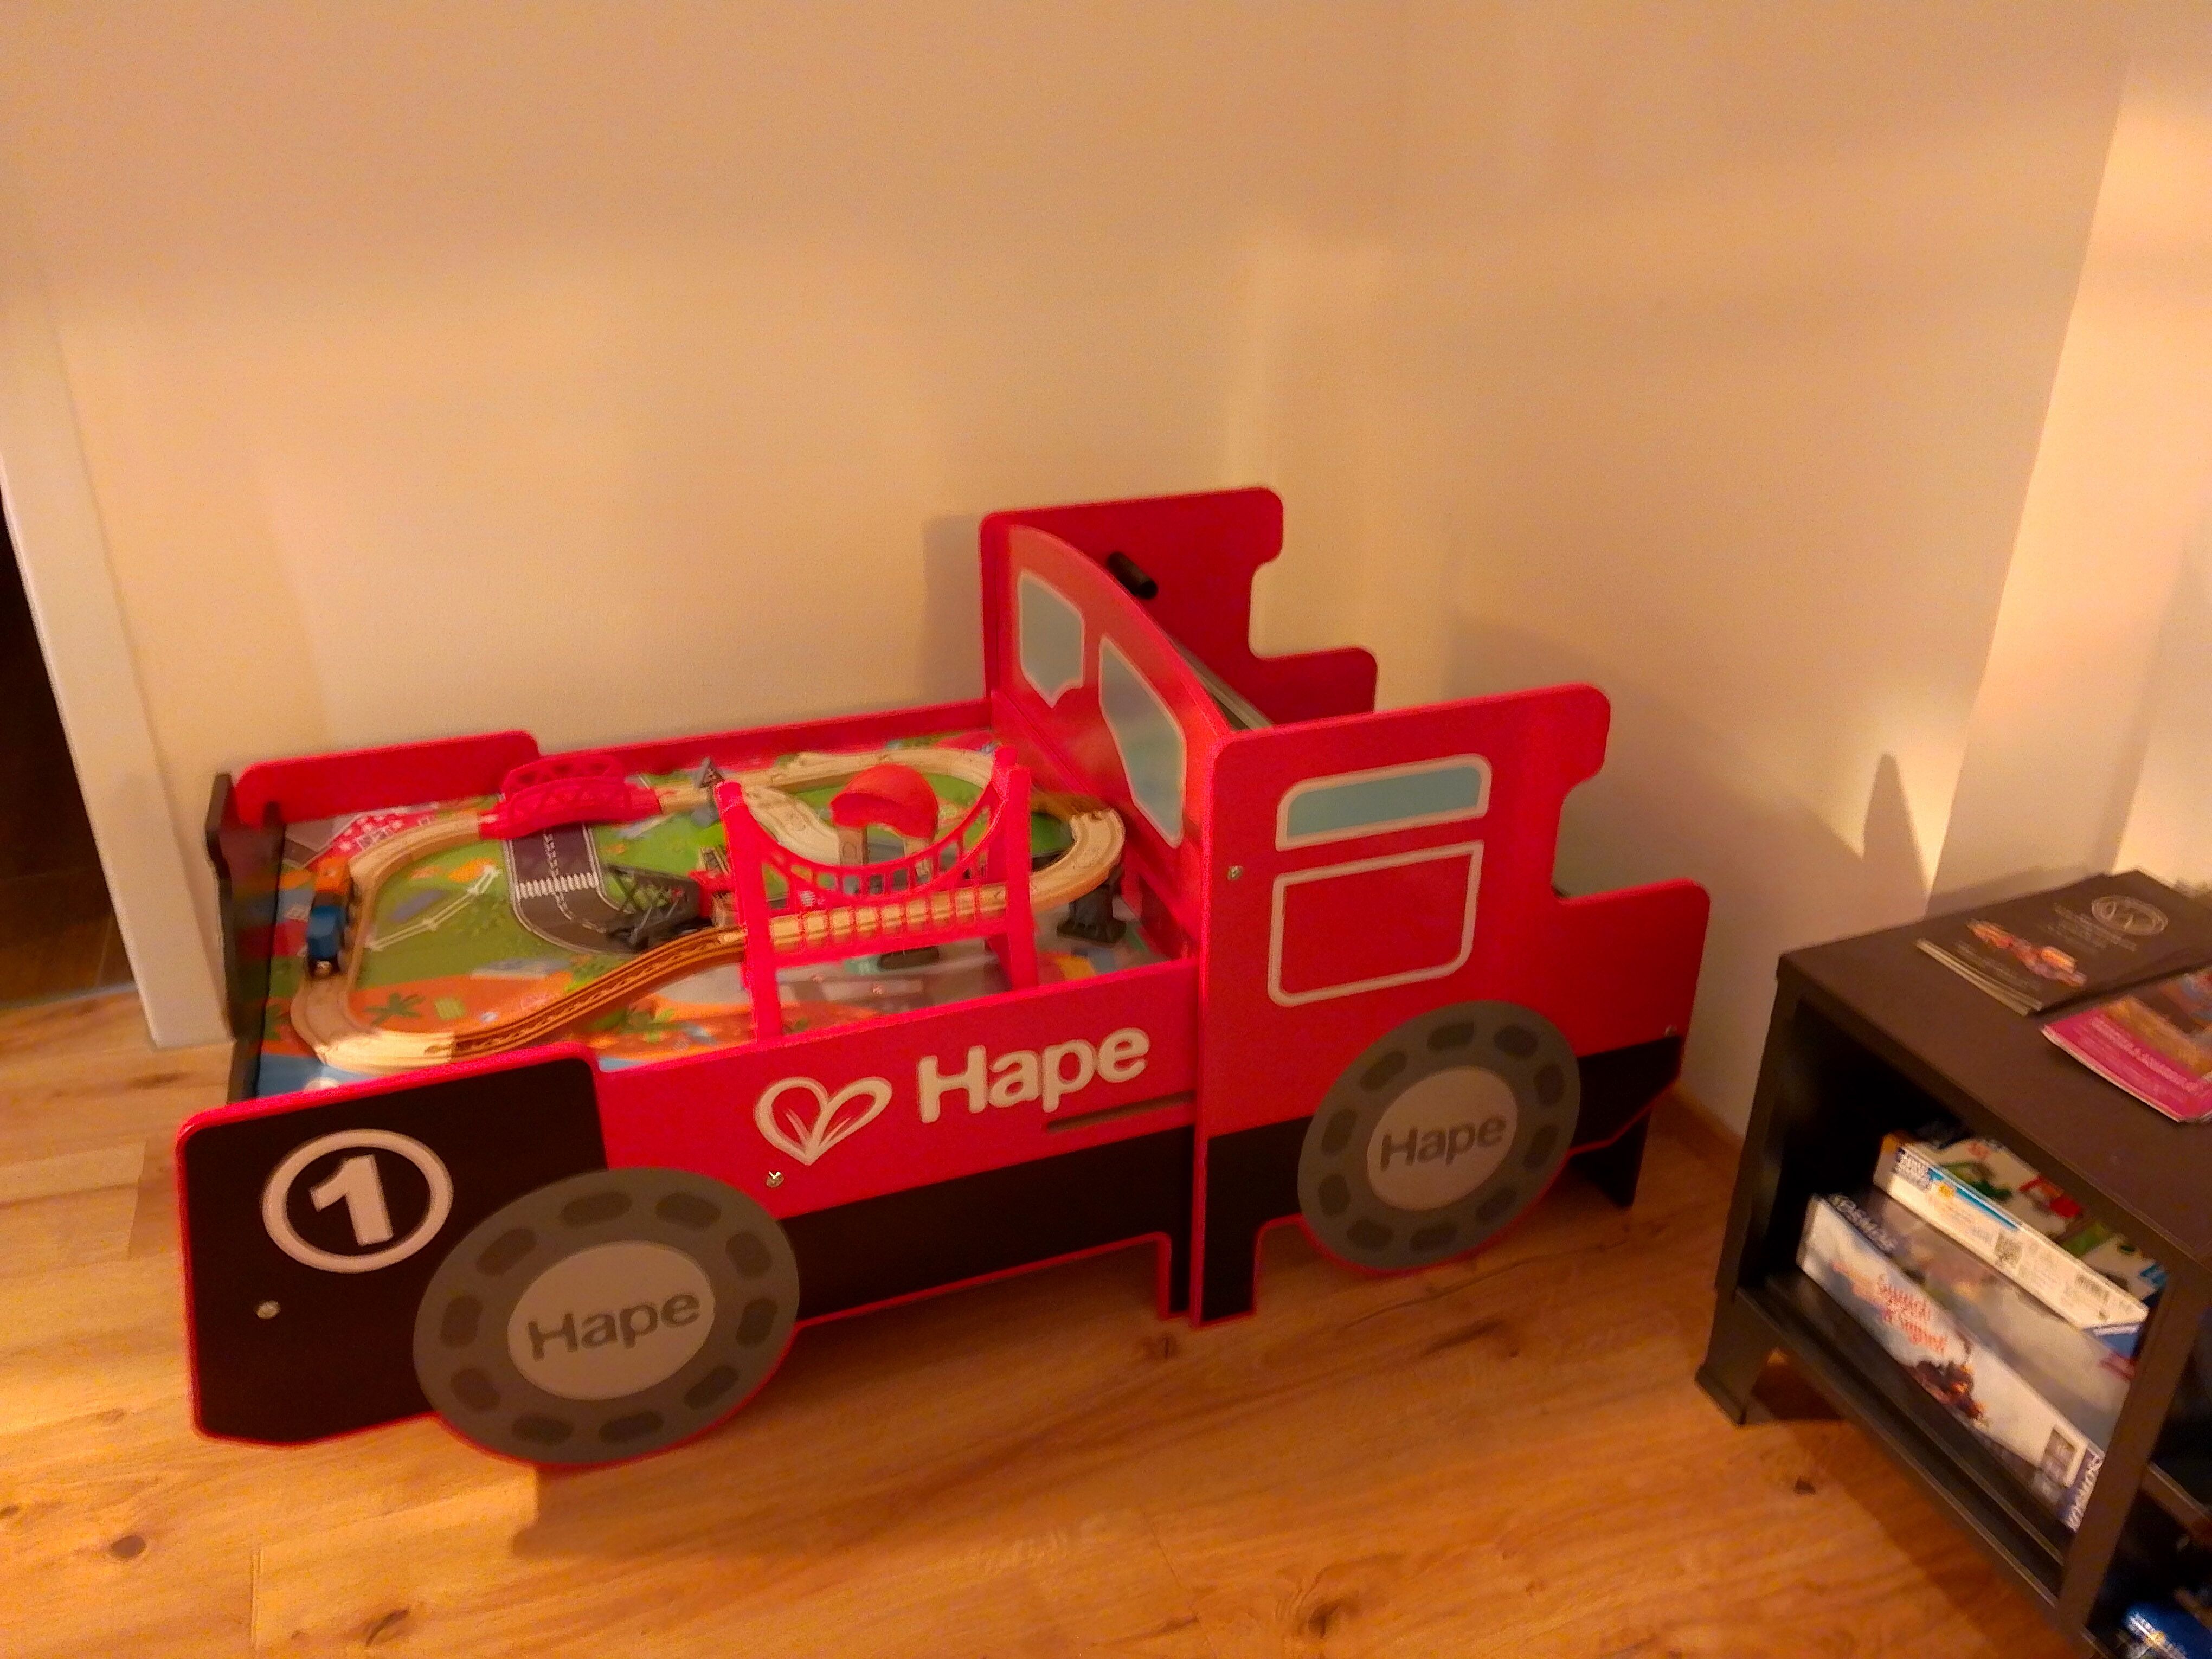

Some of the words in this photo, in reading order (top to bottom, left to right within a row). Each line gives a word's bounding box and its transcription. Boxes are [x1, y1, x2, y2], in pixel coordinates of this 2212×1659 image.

[917, 1027, 1150, 1123] Hape
[1380, 1114, 1507, 1171] Hape
[310, 1153, 394, 1246] 1
[527, 1290, 700, 1360] Hape
